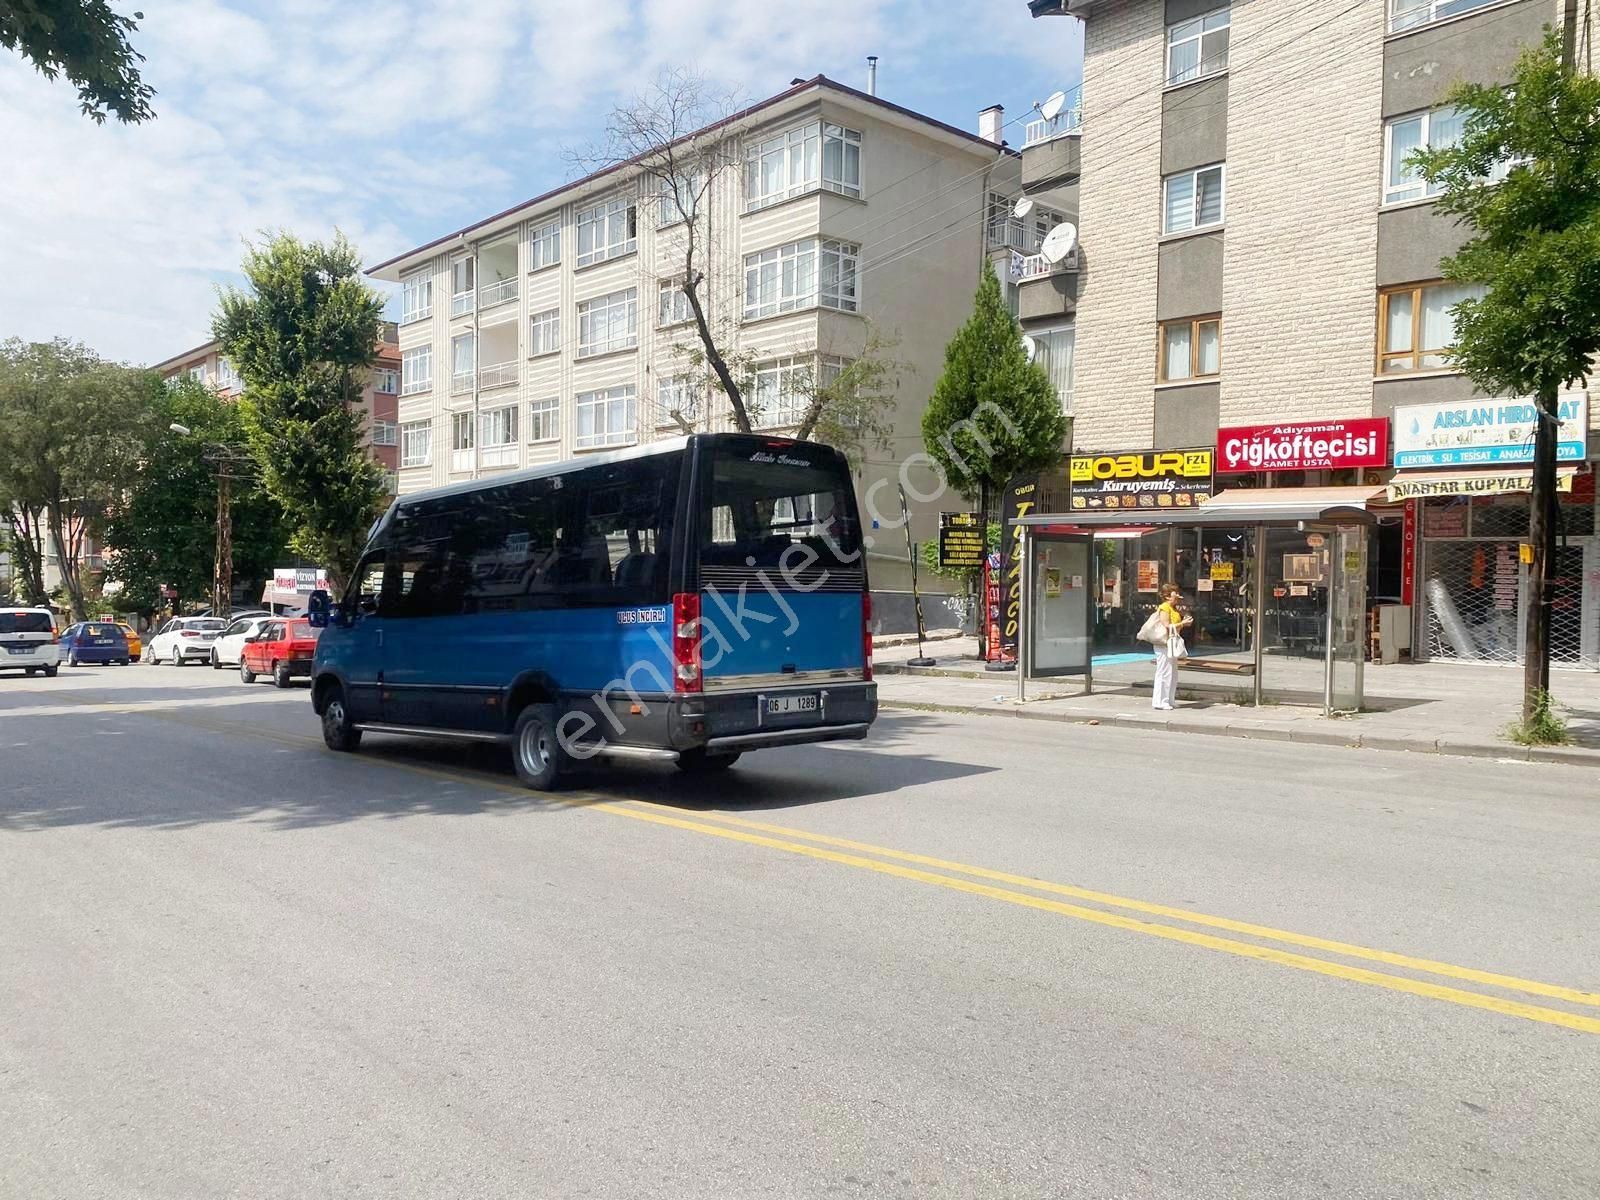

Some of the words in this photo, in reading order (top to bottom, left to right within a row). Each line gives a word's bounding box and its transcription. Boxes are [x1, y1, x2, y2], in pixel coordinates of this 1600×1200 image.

[1433, 408, 1494, 429] ARSLAN
[1497, 401, 1581, 425] HIRDAT
[1225, 431, 1377, 468] Çiğköftecisi
[1441, 453, 1453, 462] SU
[1556, 446, 1577, 456] OYA
[1072, 461, 1091, 470] FZL
[1092, 453, 1184, 479] OBUR
[1186, 455, 1208, 465] FZL
[1263, 460, 1299, 468] SAMET
[1302, 458, 1332, 466] USTA
[1014, 484, 1036, 496] OBUR
[1102, 479, 1176, 494] Kuruyemiş
[616, 610, 637, 624] ULUS
[636, 608, 666, 624] İNCİRLİ
[769, 699, 780, 712] 06
[783, 698, 790, 711] J
[797, 696, 816, 710] 1289
